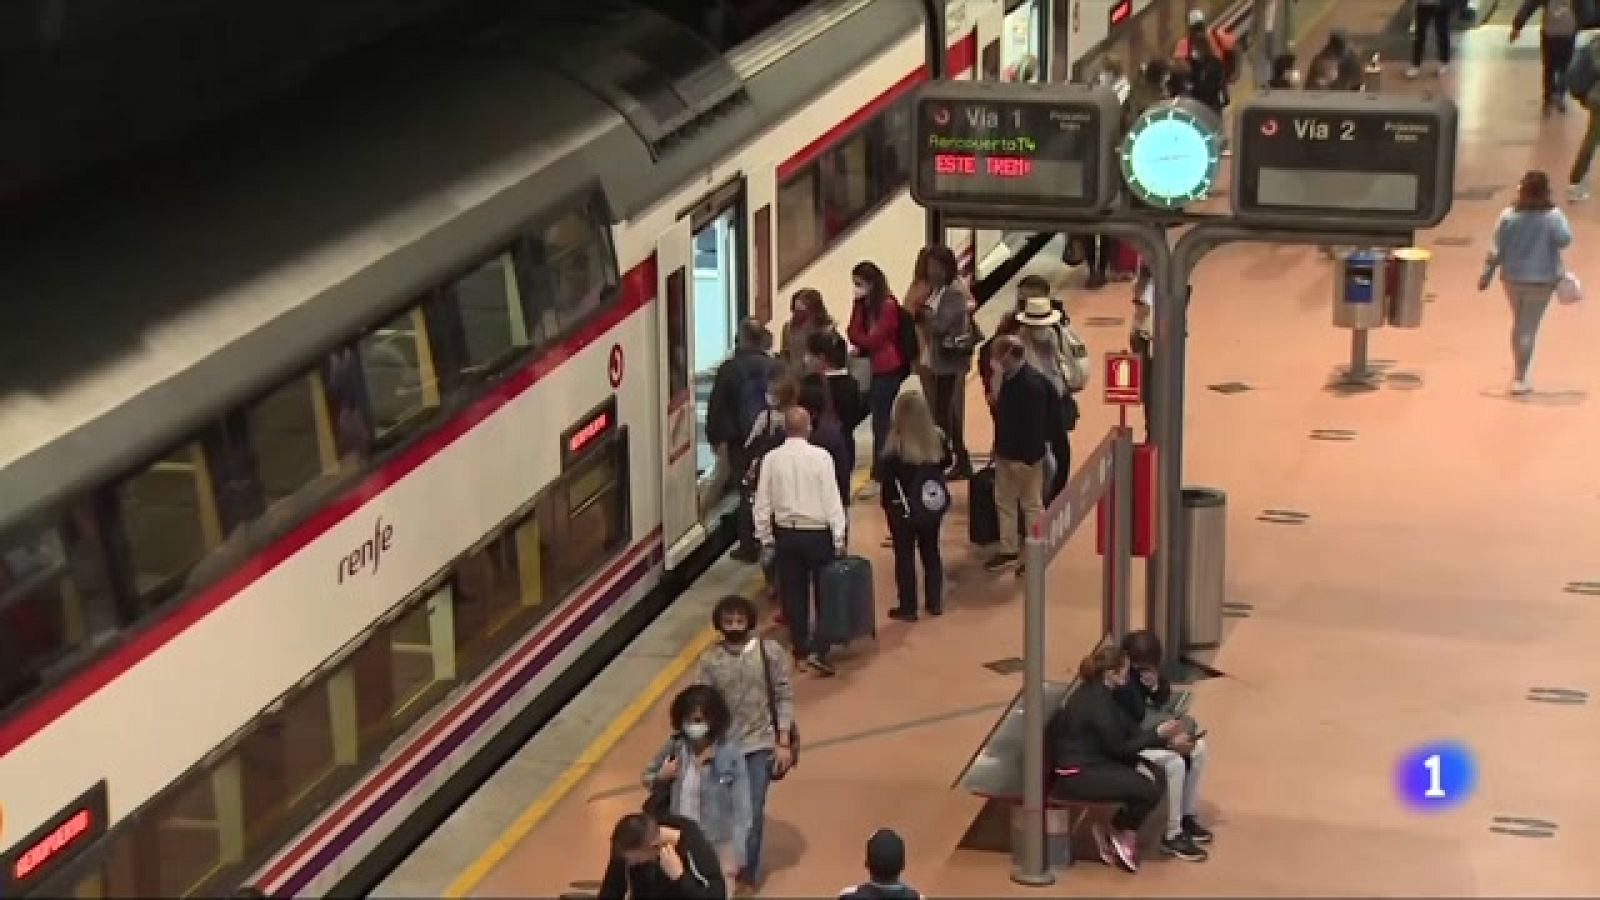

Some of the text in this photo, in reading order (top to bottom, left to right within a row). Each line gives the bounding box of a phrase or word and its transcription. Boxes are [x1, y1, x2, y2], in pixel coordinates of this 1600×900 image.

[1340, 119, 1355, 141] 2
[935, 154, 976, 174] ESTE
[337, 514, 393, 585] renfe
